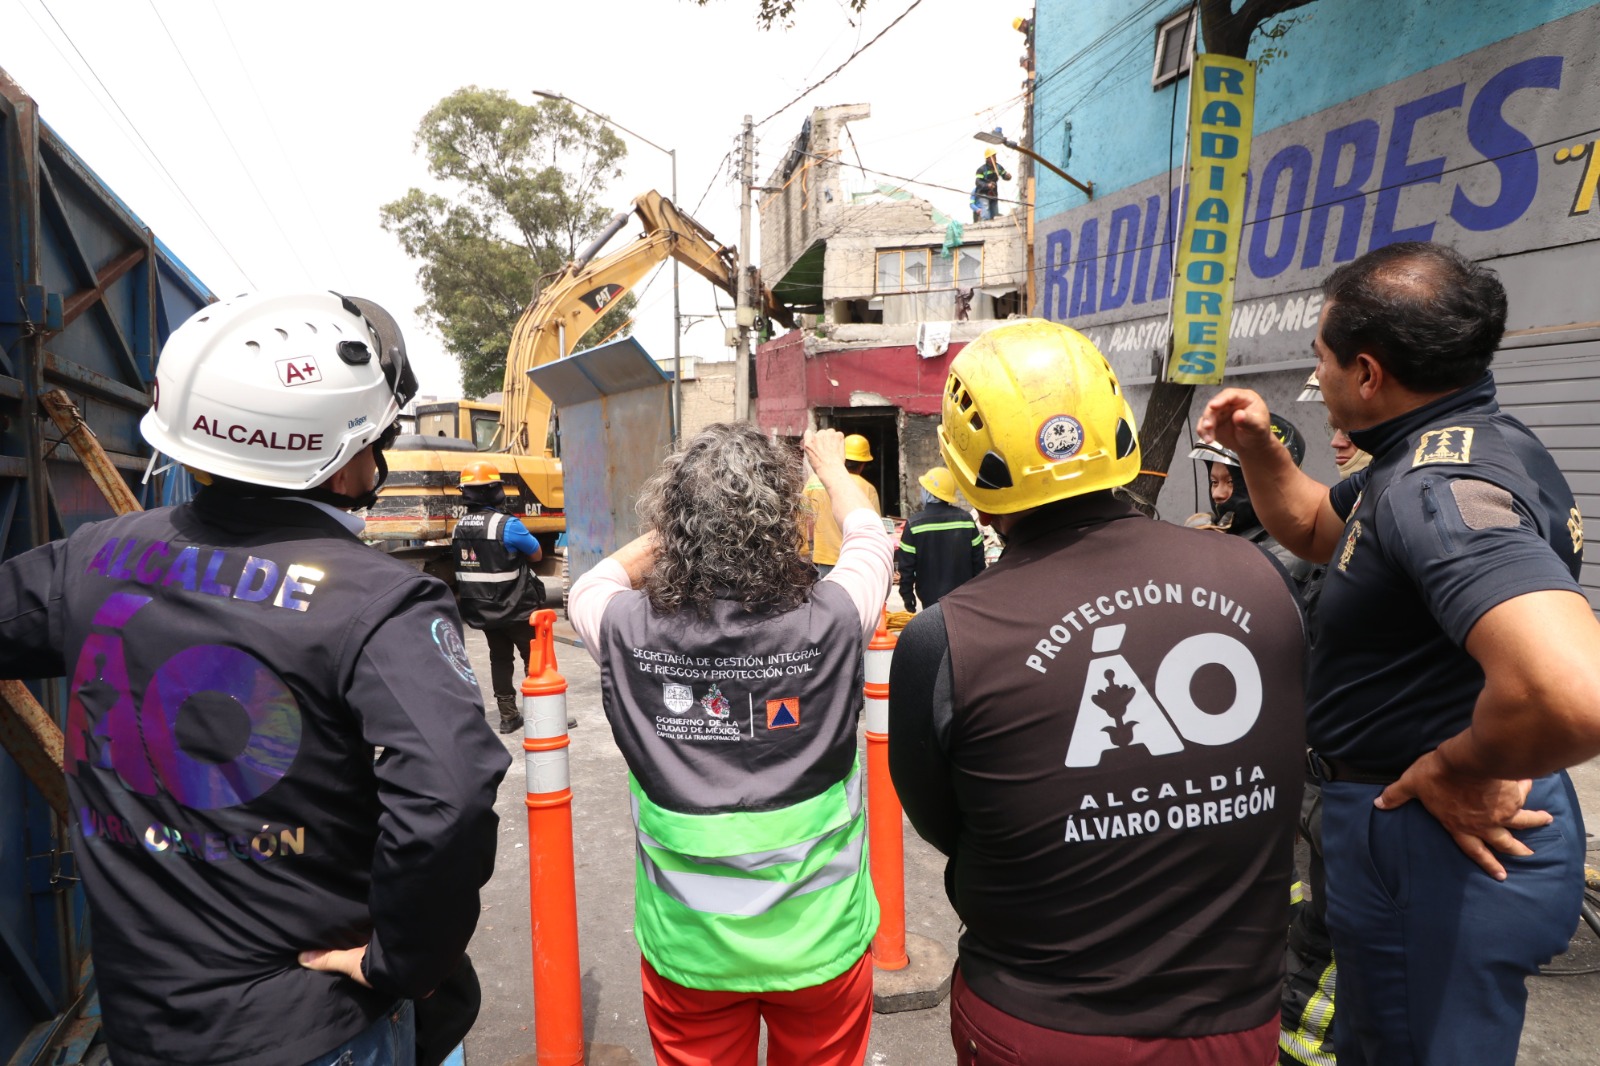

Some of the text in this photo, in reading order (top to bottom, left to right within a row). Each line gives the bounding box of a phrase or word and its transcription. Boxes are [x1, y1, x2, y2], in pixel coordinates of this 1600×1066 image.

[1178, 65, 1245, 375] RADIADORES
[595, 286, 612, 309] CAT
[1108, 320, 1174, 353] PLASTIC
[286, 362, 316, 384] A+
[192, 414, 324, 451] ALCALDE
[525, 503, 542, 516] CAT
[85, 537, 325, 612] ALCALDE
[1025, 580, 1252, 674] PROTECCIÓN CIVIL
[633, 647, 821, 667] SECRETARÍA DE GESTIÓN INTEGRAL
[639, 661, 813, 679] DE RIESGOS Y PROTECCIÓN CIVIL
[1065, 623, 1263, 768] ÁO
[656, 715, 704, 726] GOBIERNO
[709, 719, 721, 727] DE
[656, 723, 688, 733] CIUDAD
[705, 726, 740, 735] MÉXICO
[656, 731, 676, 740] CAPITAL
[1080, 765, 1265, 810] ALCALDÍA
[1065, 785, 1276, 842] ÁLVARO OBREGÓN
